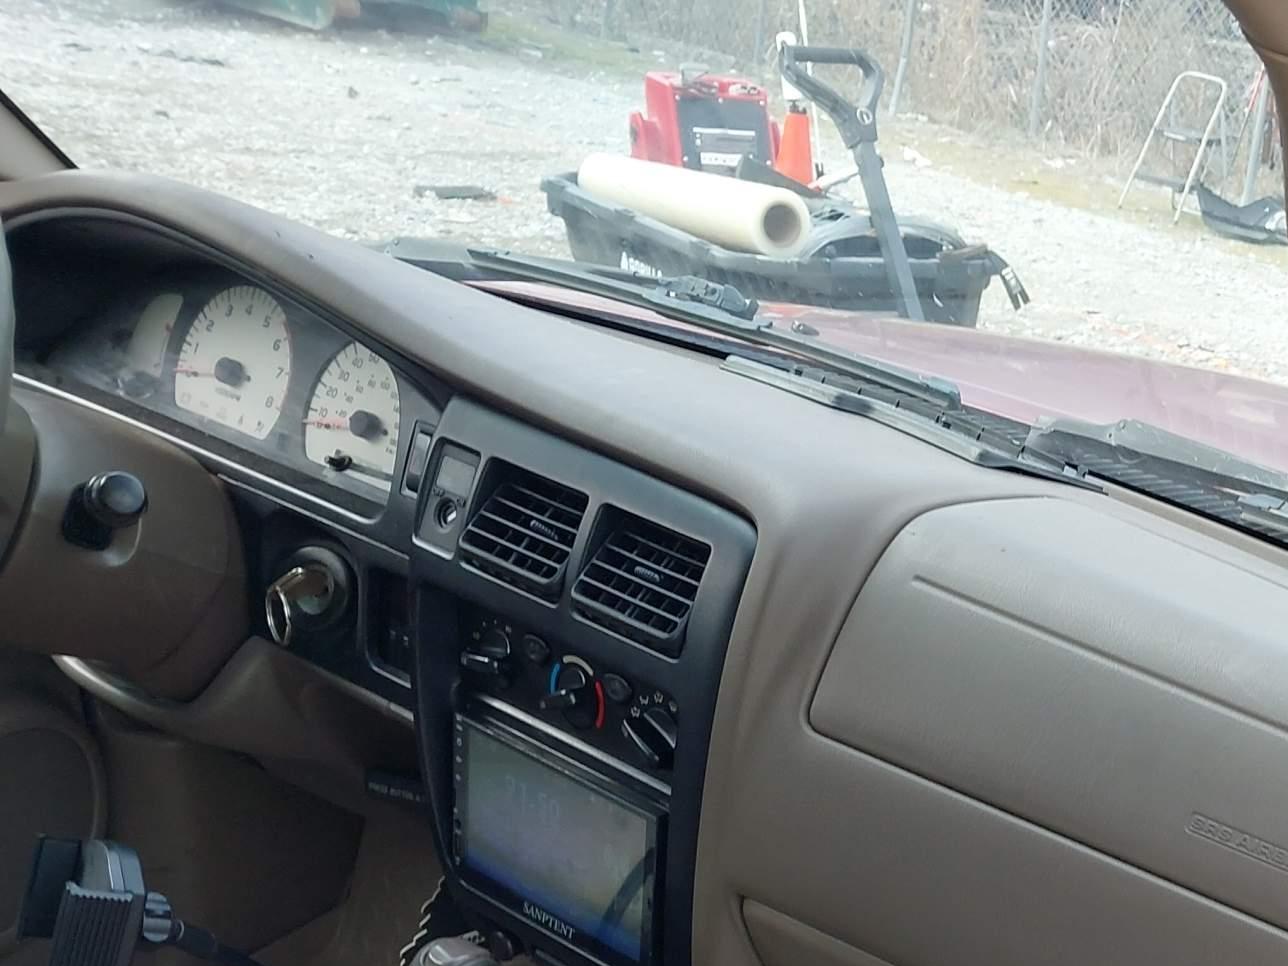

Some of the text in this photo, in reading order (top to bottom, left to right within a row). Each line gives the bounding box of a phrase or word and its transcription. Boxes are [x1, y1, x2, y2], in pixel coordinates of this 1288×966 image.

[225, 303, 234, 317] 3
[245, 303, 253, 316] 4
[206, 319, 215, 332] 2
[262, 315, 272, 329] 5
[193, 343, 199, 355] 1
[272, 338, 282, 352] 6
[351, 358, 364, 369] 40
[275, 366, 285, 379] 7
[326, 386, 338, 399] 20
[264, 395, 274, 408] 8
[318, 407, 328, 418] 10
[1191, 817, 1233, 842] SRS
[522, 900, 576, 940] SANPTENT
